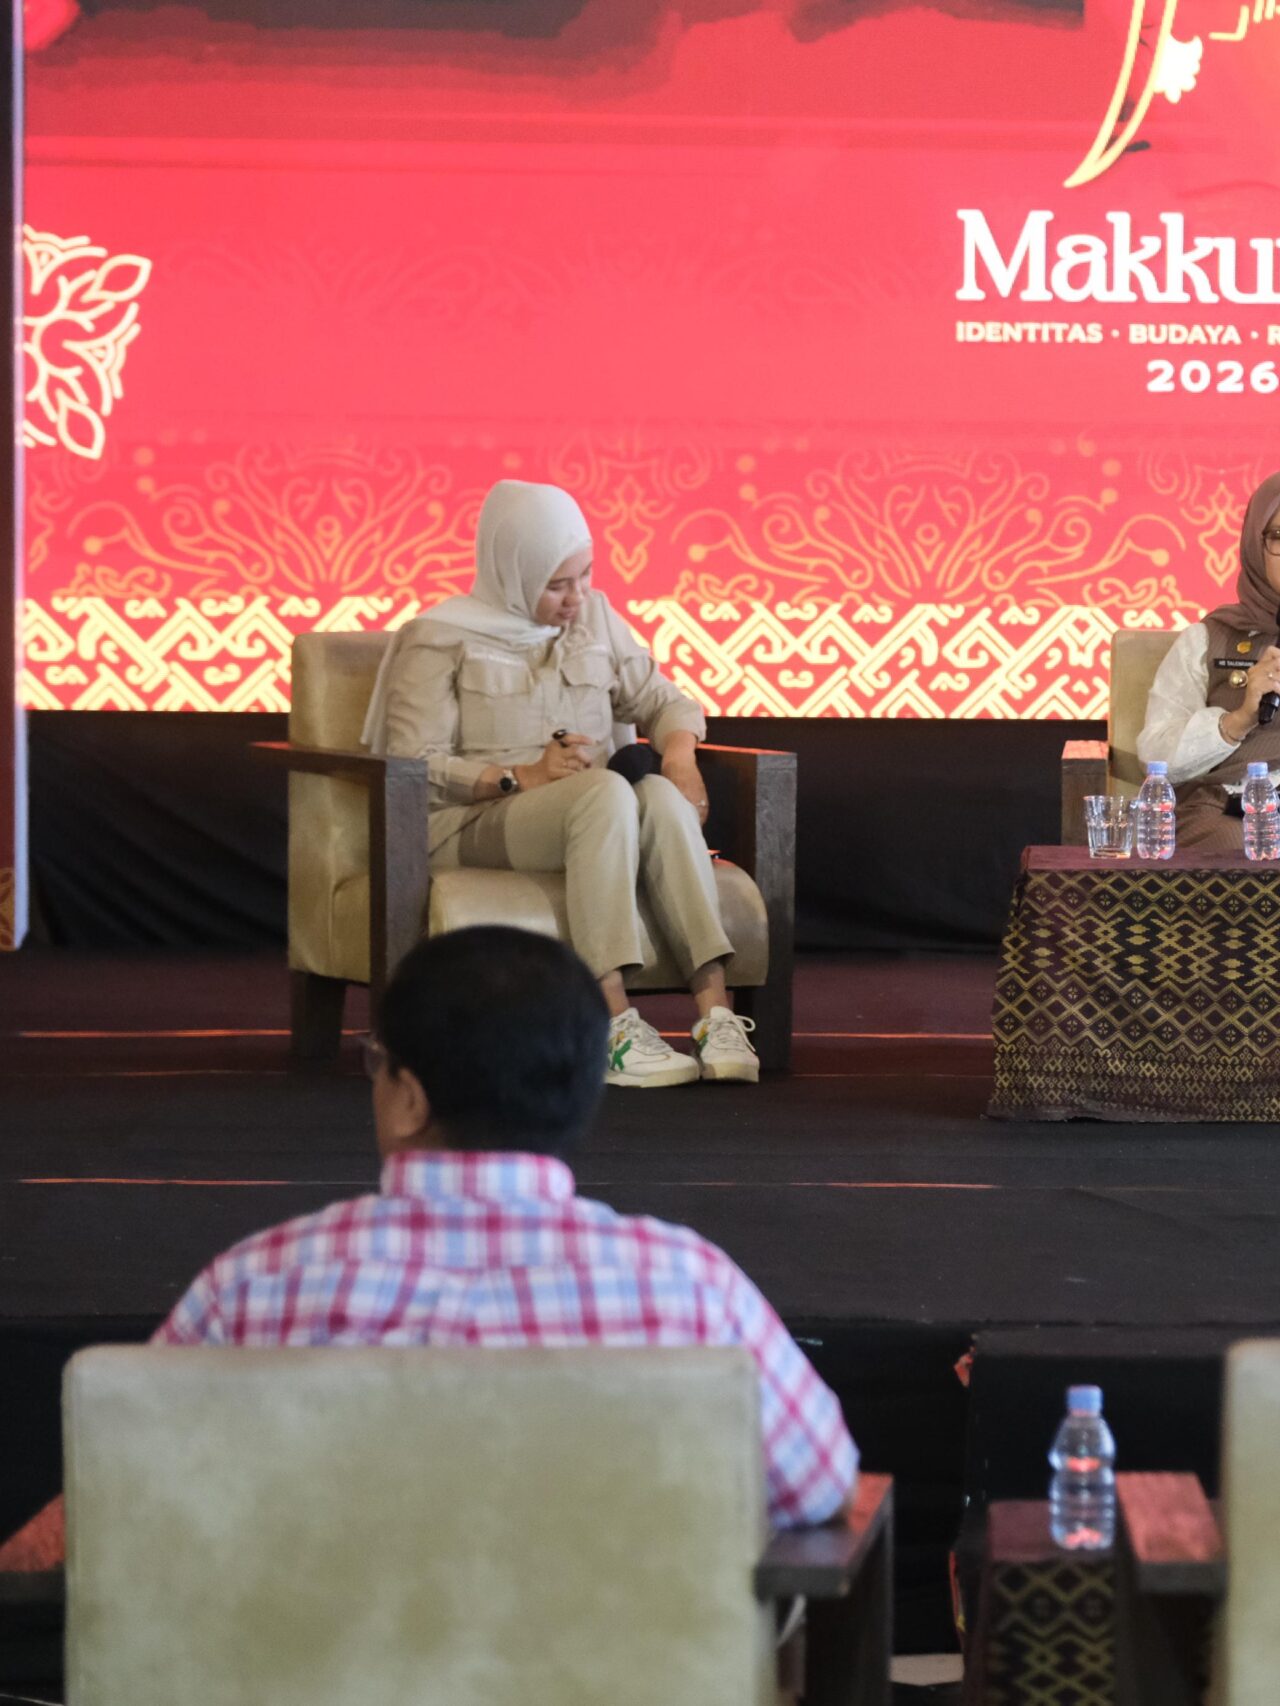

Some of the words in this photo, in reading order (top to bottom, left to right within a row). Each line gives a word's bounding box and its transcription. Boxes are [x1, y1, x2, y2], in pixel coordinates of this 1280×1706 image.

[955, 320, 1104, 345] IDENTITAS
[1128, 322, 1243, 346] BUDAYA
[1146, 358, 1280, 394] 2026
